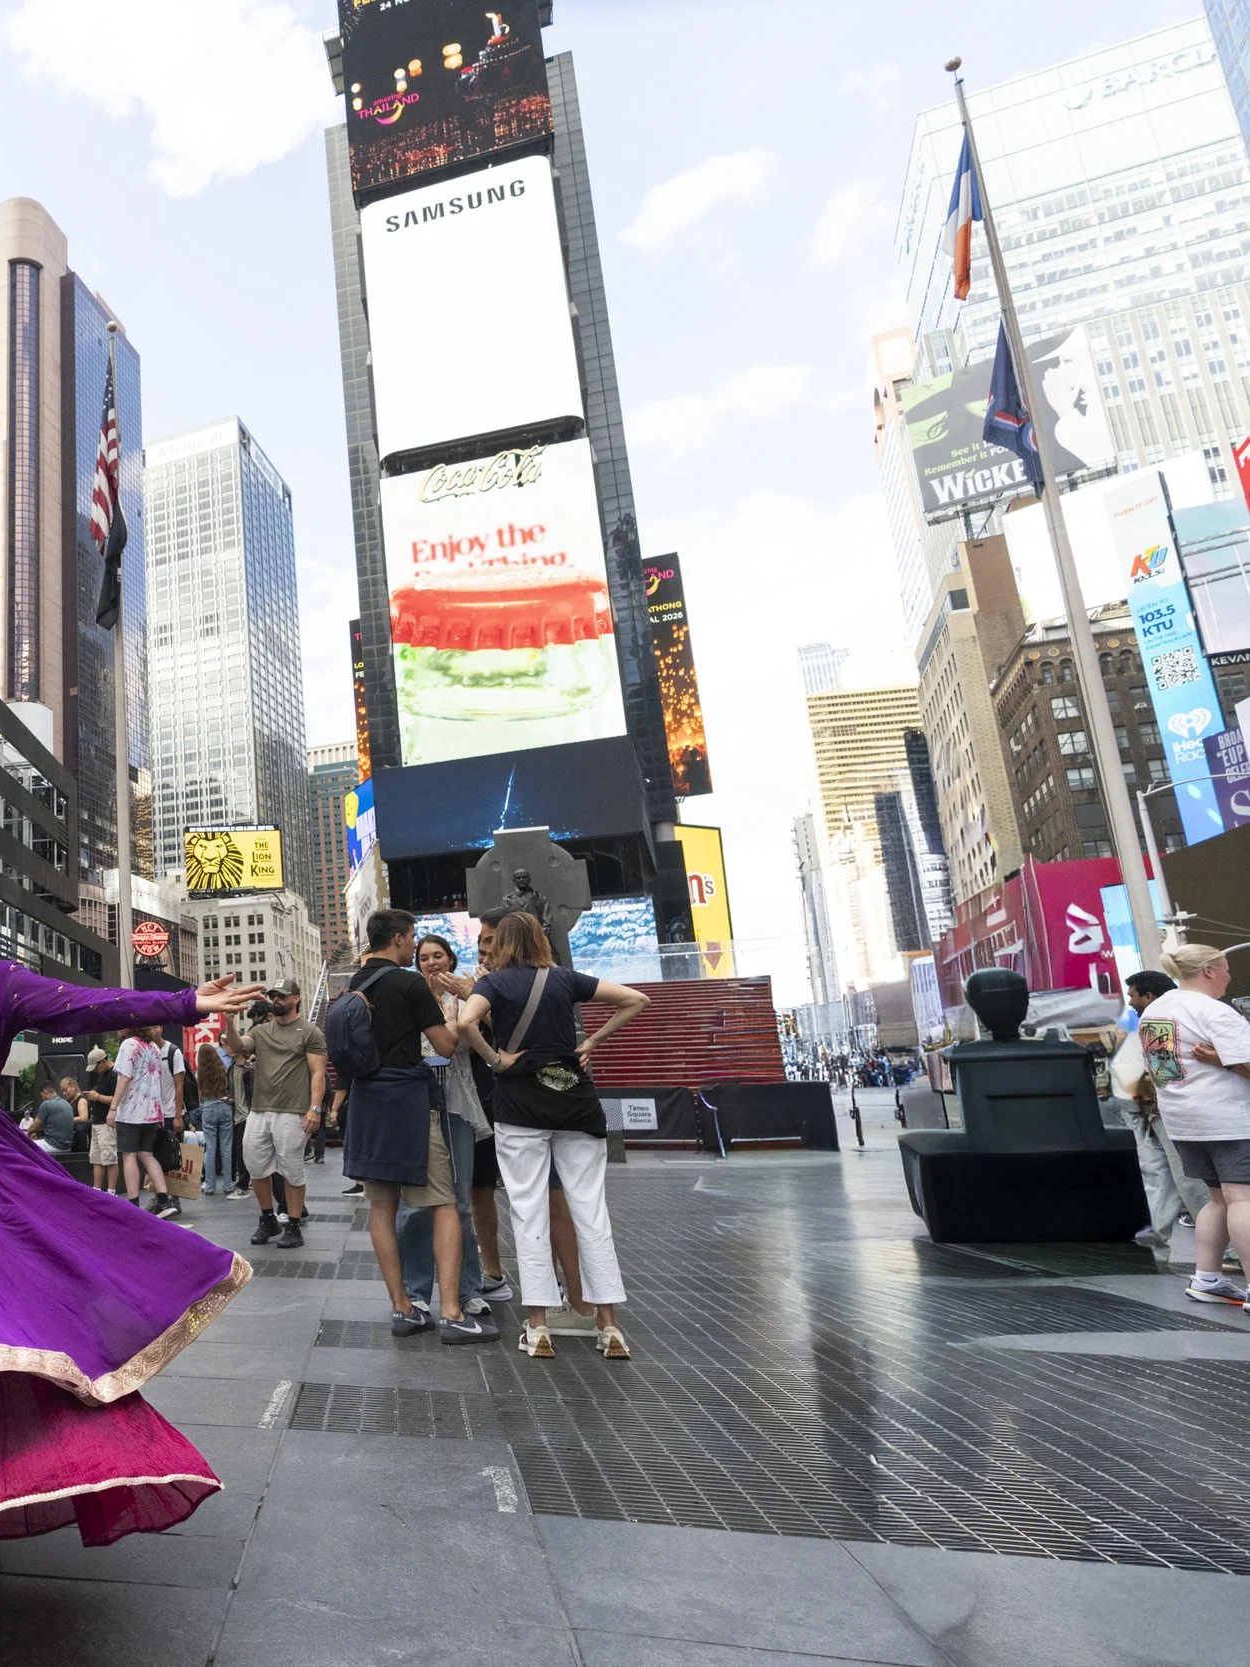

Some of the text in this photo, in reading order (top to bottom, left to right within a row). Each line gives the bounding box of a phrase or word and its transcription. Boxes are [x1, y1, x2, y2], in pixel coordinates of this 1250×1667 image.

[357, 93, 420, 120] THAILAND
[385, 178, 526, 233] SAMSUNG
[924, 454, 978, 476] Remember
[979, 450, 987, 460] it
[950, 442, 981, 458] See it
[419, 444, 548, 503] Coca-Cola
[411, 531, 489, 564] Enjoy
[496, 523, 547, 549] the
[1130, 544, 1169, 578] KTU
[662, 612, 683, 622] 2026
[1138, 604, 1176, 625] 103.5
[1142, 619, 1174, 638] KTU
